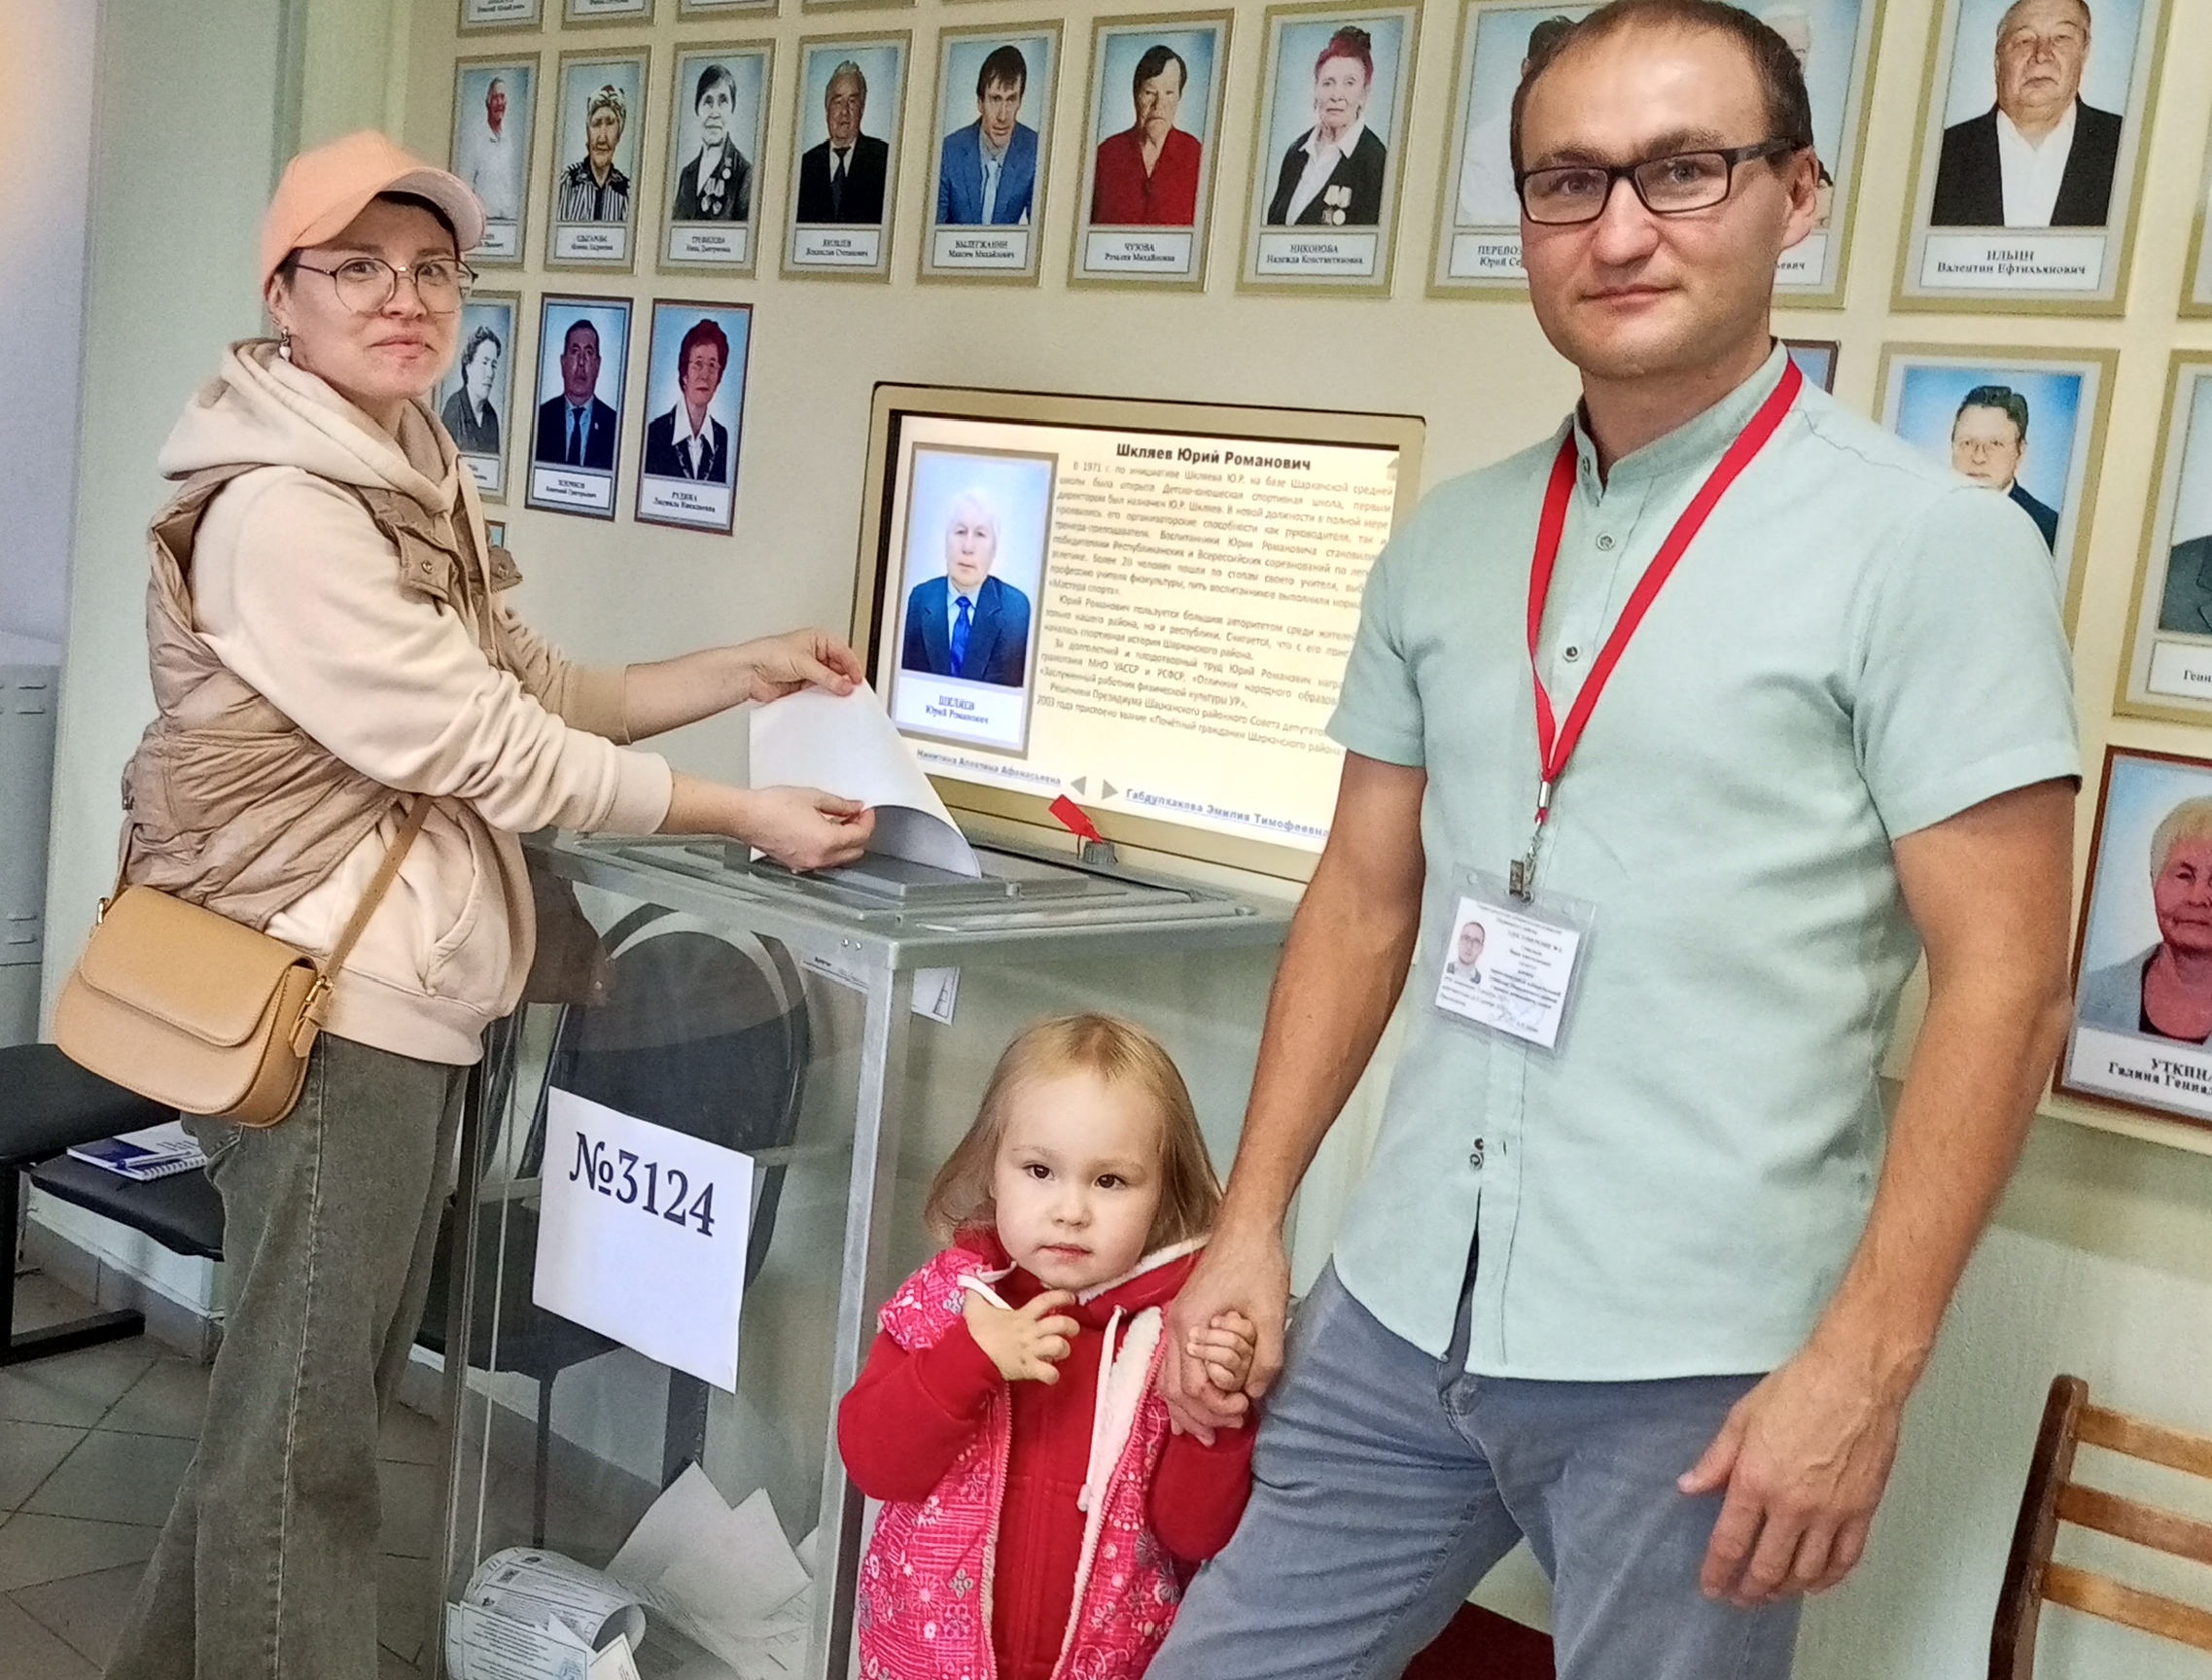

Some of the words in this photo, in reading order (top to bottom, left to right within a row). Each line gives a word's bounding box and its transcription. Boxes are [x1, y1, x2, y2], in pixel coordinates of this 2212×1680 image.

[1986, 250, 2034, 262] ИЛЬИН
[1937, 262, 1994, 274] Валентин
[1116, 443, 1173, 460] Шкляев
[1177, 448, 1219, 464] Юрий
[1224, 451, 1311, 470] Романович
[1083, 462, 1101, 472] 1971
[1130, 468, 1179, 478] инициативе
[1185, 471, 1222, 481] Шкляева
[1266, 476, 1285, 487] базе
[1291, 479, 1348, 492] Шарканской
[1353, 485, 1392, 496] средней
[1093, 478, 1112, 488] была
[1120, 481, 1154, 492] открыта
[1252, 493, 1303, 505] спортивная
[1353, 503, 1390, 512] первым
[1057, 491, 1106, 503] директором
[1108, 495, 1124, 504] был
[1127, 497, 1165, 508] назначен
[1227, 505, 1233, 513] В
[1236, 507, 1262, 517] новой
[1265, 510, 1315, 521] должности
[1326, 516, 1360, 526] полной
[1364, 520, 1387, 530] мере
[1126, 512, 1197, 527] организаторские
[1203, 519, 1258, 533] способности
[1228, 537, 1252, 549] Юрия
[1262, 541, 1317, 555] Романовича
[1326, 548, 1377, 560] становили
[1265, 558, 1330, 573] соревнований
[1265, 575, 1294, 585] своего
[1059, 595, 1081, 606] Юрий
[1085, 598, 1130, 612] Романович
[1226, 617, 1282, 632] авторитетом
[1286, 625, 1314, 636] среди
[1127, 635, 1161, 647] история
[1163, 639, 1217, 655] Шарканского
[1277, 641, 1291, 649] что
[1306, 645, 1321, 653] его
[1204, 661, 1223, 673] труд
[1230, 663, 1254, 676] Юрий
[1261, 669, 1311, 683] Романович
[1098, 676, 1135, 689] работник
[1189, 692, 1227, 705] культуры
[1245, 684, 1291, 697] народного
[939, 695, 974, 711] ШКЛЯЕВ
[1093, 689, 1141, 707] Президиума
[1144, 698, 1200, 717] Шарканского
[1202, 710, 1247, 724] районного
[1250, 716, 1280, 729] Совета
[1282, 722, 1326, 736] депутато
[926, 705, 946, 717] Юрий
[949, 710, 989, 724] Романович
[1056, 700, 1073, 711] года
[1199, 724, 1245, 739] гражданин
[1248, 731, 1305, 750] Шарканского
[917, 749, 957, 763] Никитина
[1001, 766, 1061, 785] Афанасьевна
[1207, 805, 1249, 822] Эмилия
[2109, 1062, 2159, 1084] Галина
[569, 1131, 715, 1237] №3124
